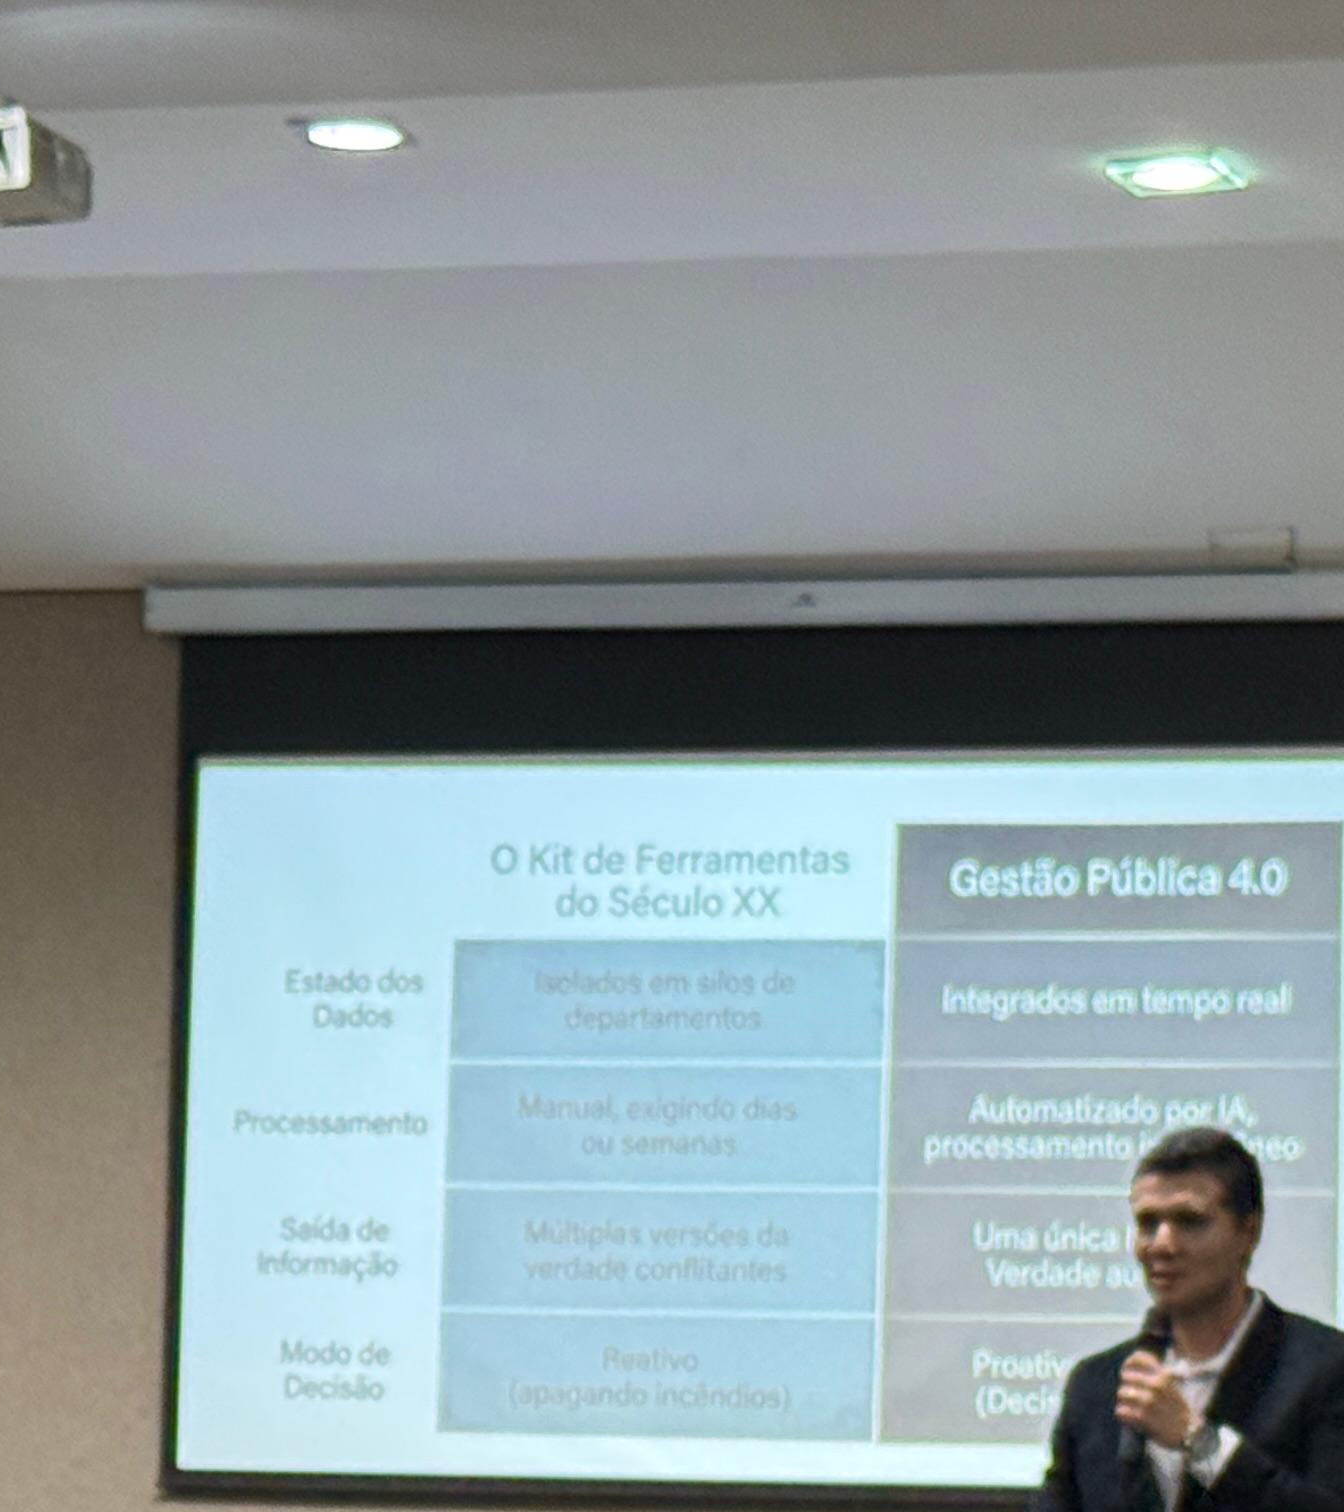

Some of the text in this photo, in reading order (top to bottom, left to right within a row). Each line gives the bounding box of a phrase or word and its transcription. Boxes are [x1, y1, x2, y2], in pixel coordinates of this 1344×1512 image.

[490, 843, 850, 876] O Kit de Ferramentas
[951, 858, 1288, 897] Gestão Pública 4.0
[556, 884, 782, 917] do Século XX
[285, 969, 424, 994] Estado dos
[535, 969, 796, 995] Isolados em silos de
[314, 1004, 394, 1029] Dados
[943, 983, 1291, 1020] Integrados em tempo real
[565, 1006, 762, 1032] departamentos
[234, 1110, 429, 1136] Processamento
[519, 1096, 797, 1126] Manual, exigindo dias
[969, 1094, 1258, 1128] Automatizado por IA,
[582, 1135, 737, 1155] ou semanas
[924, 1129, 1133, 1164] processamento
[280, 1216, 390, 1243] Saída de
[524, 1220, 790, 1250] Múltiplas versões da
[973, 1221, 1035, 1252] Uma
[1043, 1219, 1119, 1252] única
[256, 1252, 397, 1286] Informação
[525, 1257, 787, 1284] verdade conflitantes
[985, 1258, 1102, 1288] Verdade
[280, 1341, 391, 1366] Modo de
[603, 1348, 699, 1372] Reativo
[972, 1347, 1076, 1378] Proativ
[283, 1377, 385, 1402] Decisão
[509, 1379, 792, 1411] (apagando incêndios)
[976, 1382, 1065, 1418] (Decis
